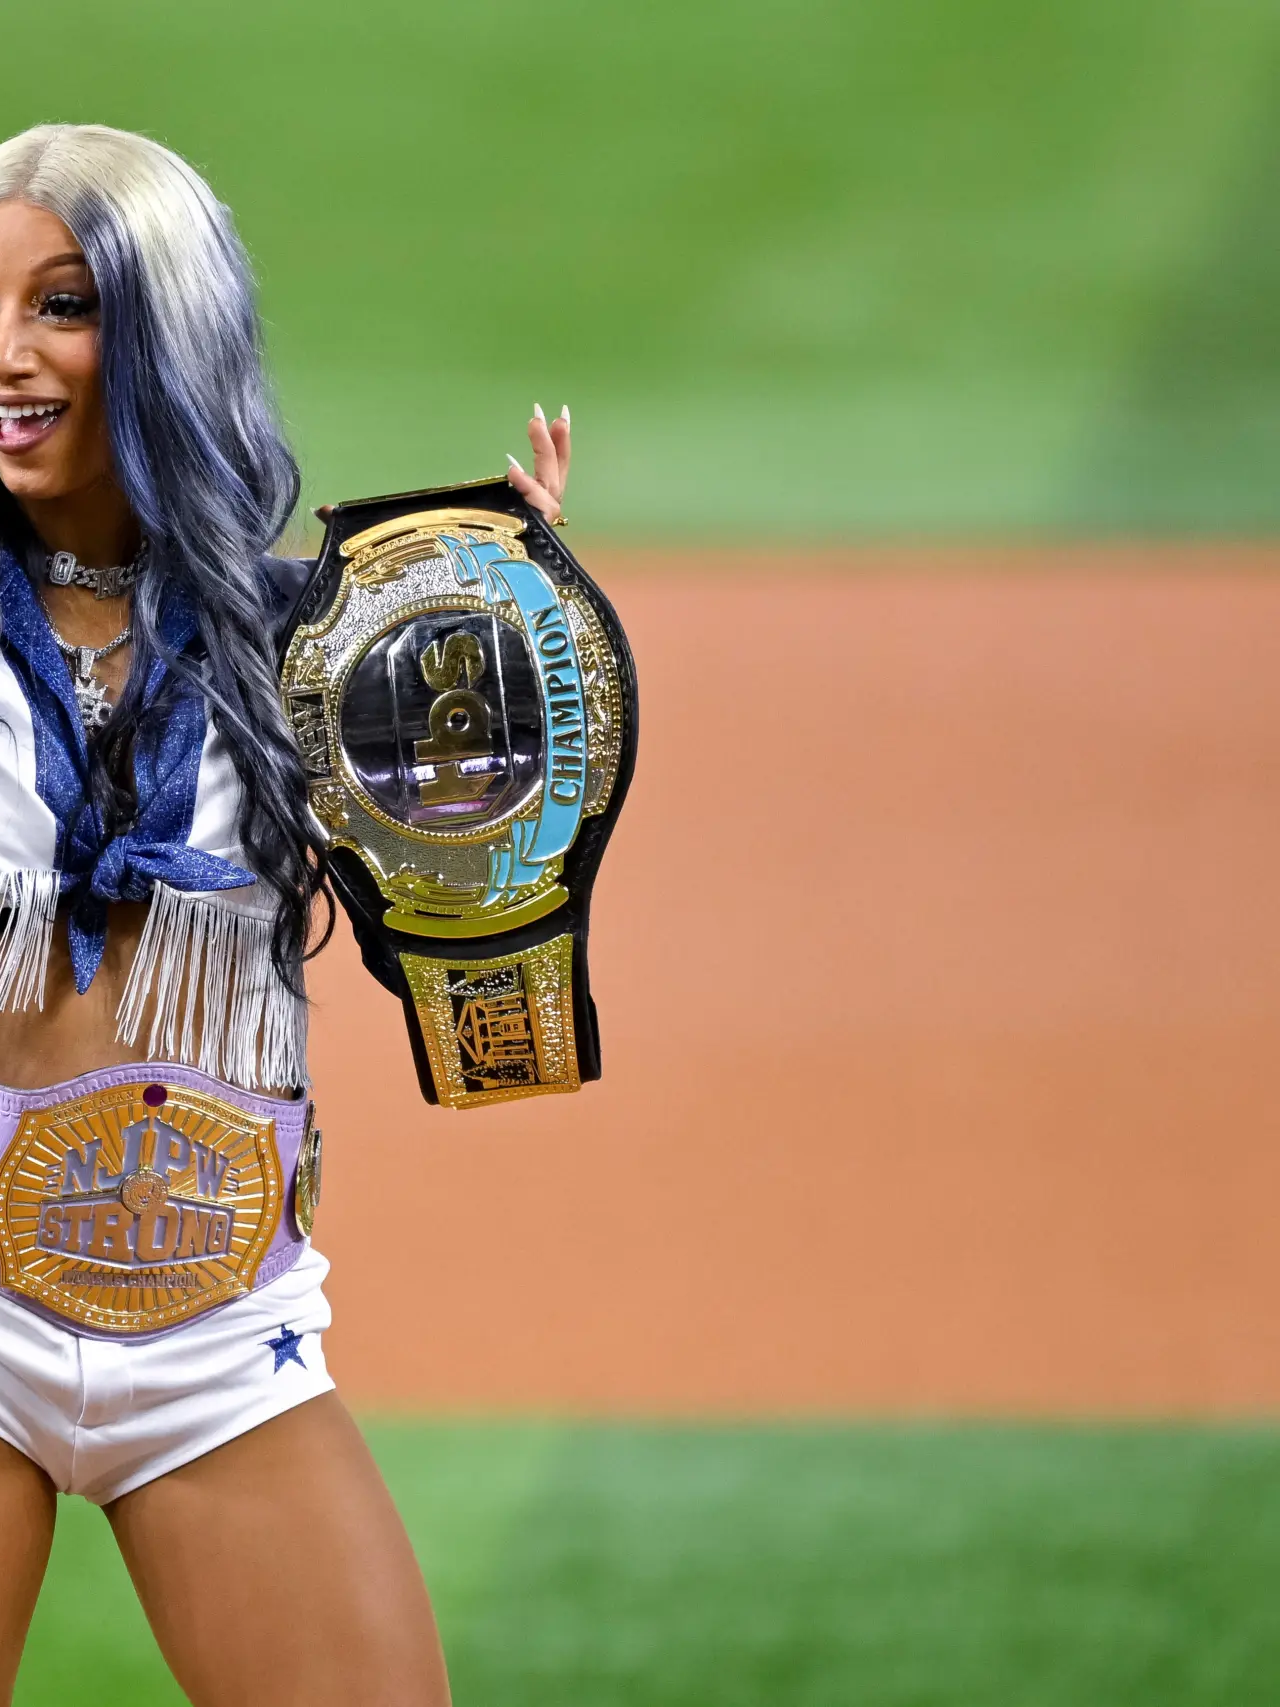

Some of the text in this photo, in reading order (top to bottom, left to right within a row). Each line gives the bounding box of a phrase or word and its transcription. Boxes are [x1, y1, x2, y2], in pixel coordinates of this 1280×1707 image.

[291, 698, 330, 777] AEW
[414, 633, 494, 806] tbs
[536, 605, 584, 807] CHAMPION
[61, 1117, 230, 1198] NJPW
[42, 1201, 228, 1262] STRONG
[127, 1272, 198, 1289] CHAMPION
